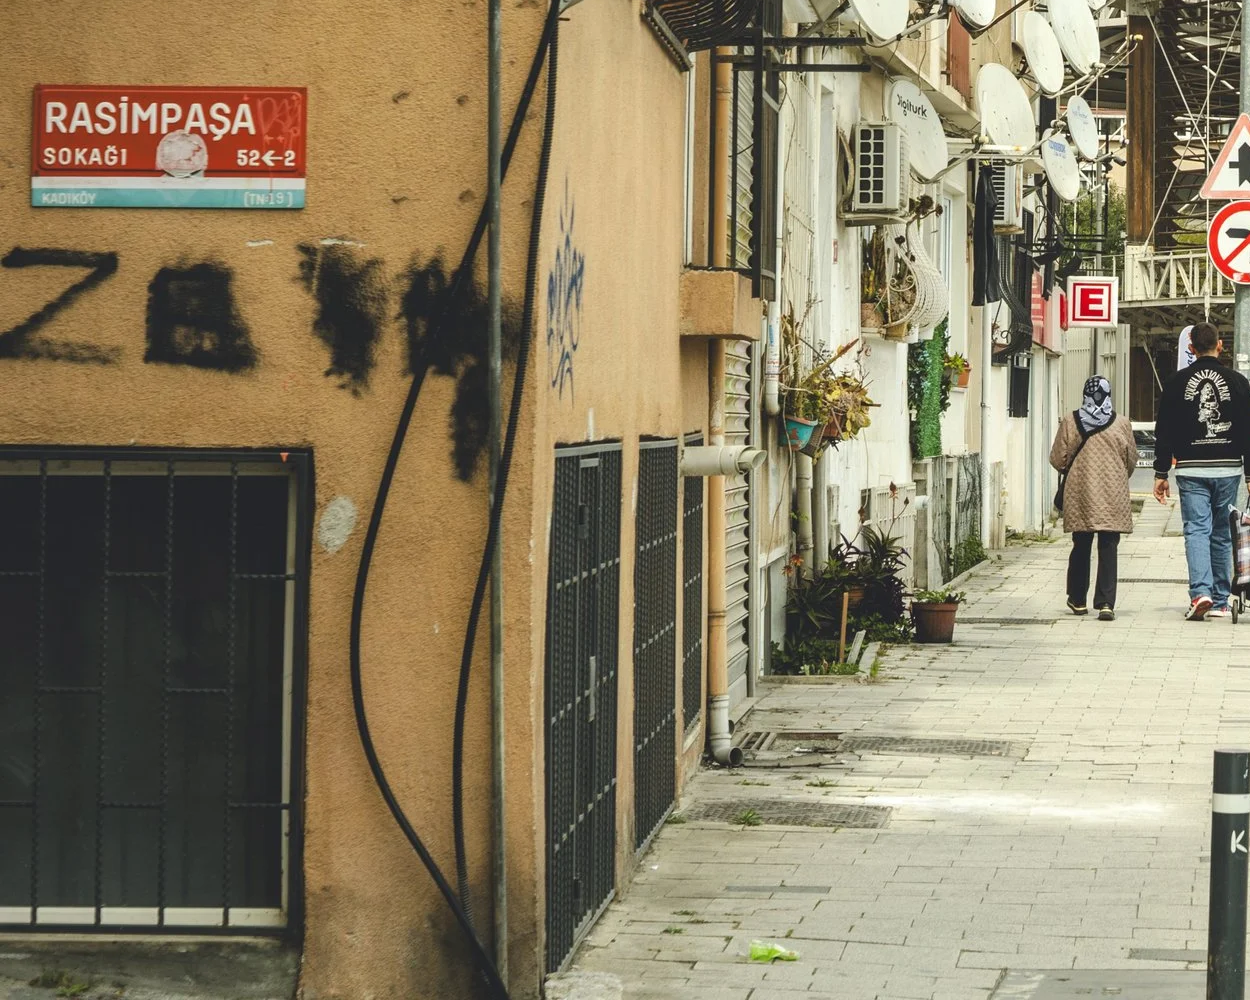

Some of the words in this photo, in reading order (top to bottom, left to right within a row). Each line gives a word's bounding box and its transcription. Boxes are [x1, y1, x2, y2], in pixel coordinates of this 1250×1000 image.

[45, 96, 256, 141] RASİMPAŞA
[43, 145, 128, 167] SOKAĞI
[236, 149, 260, 167] 52
[41, 190, 96, 205] KADIKÖY
[1080, 288, 1104, 317] E
[1230, 829, 1248, 853] K
